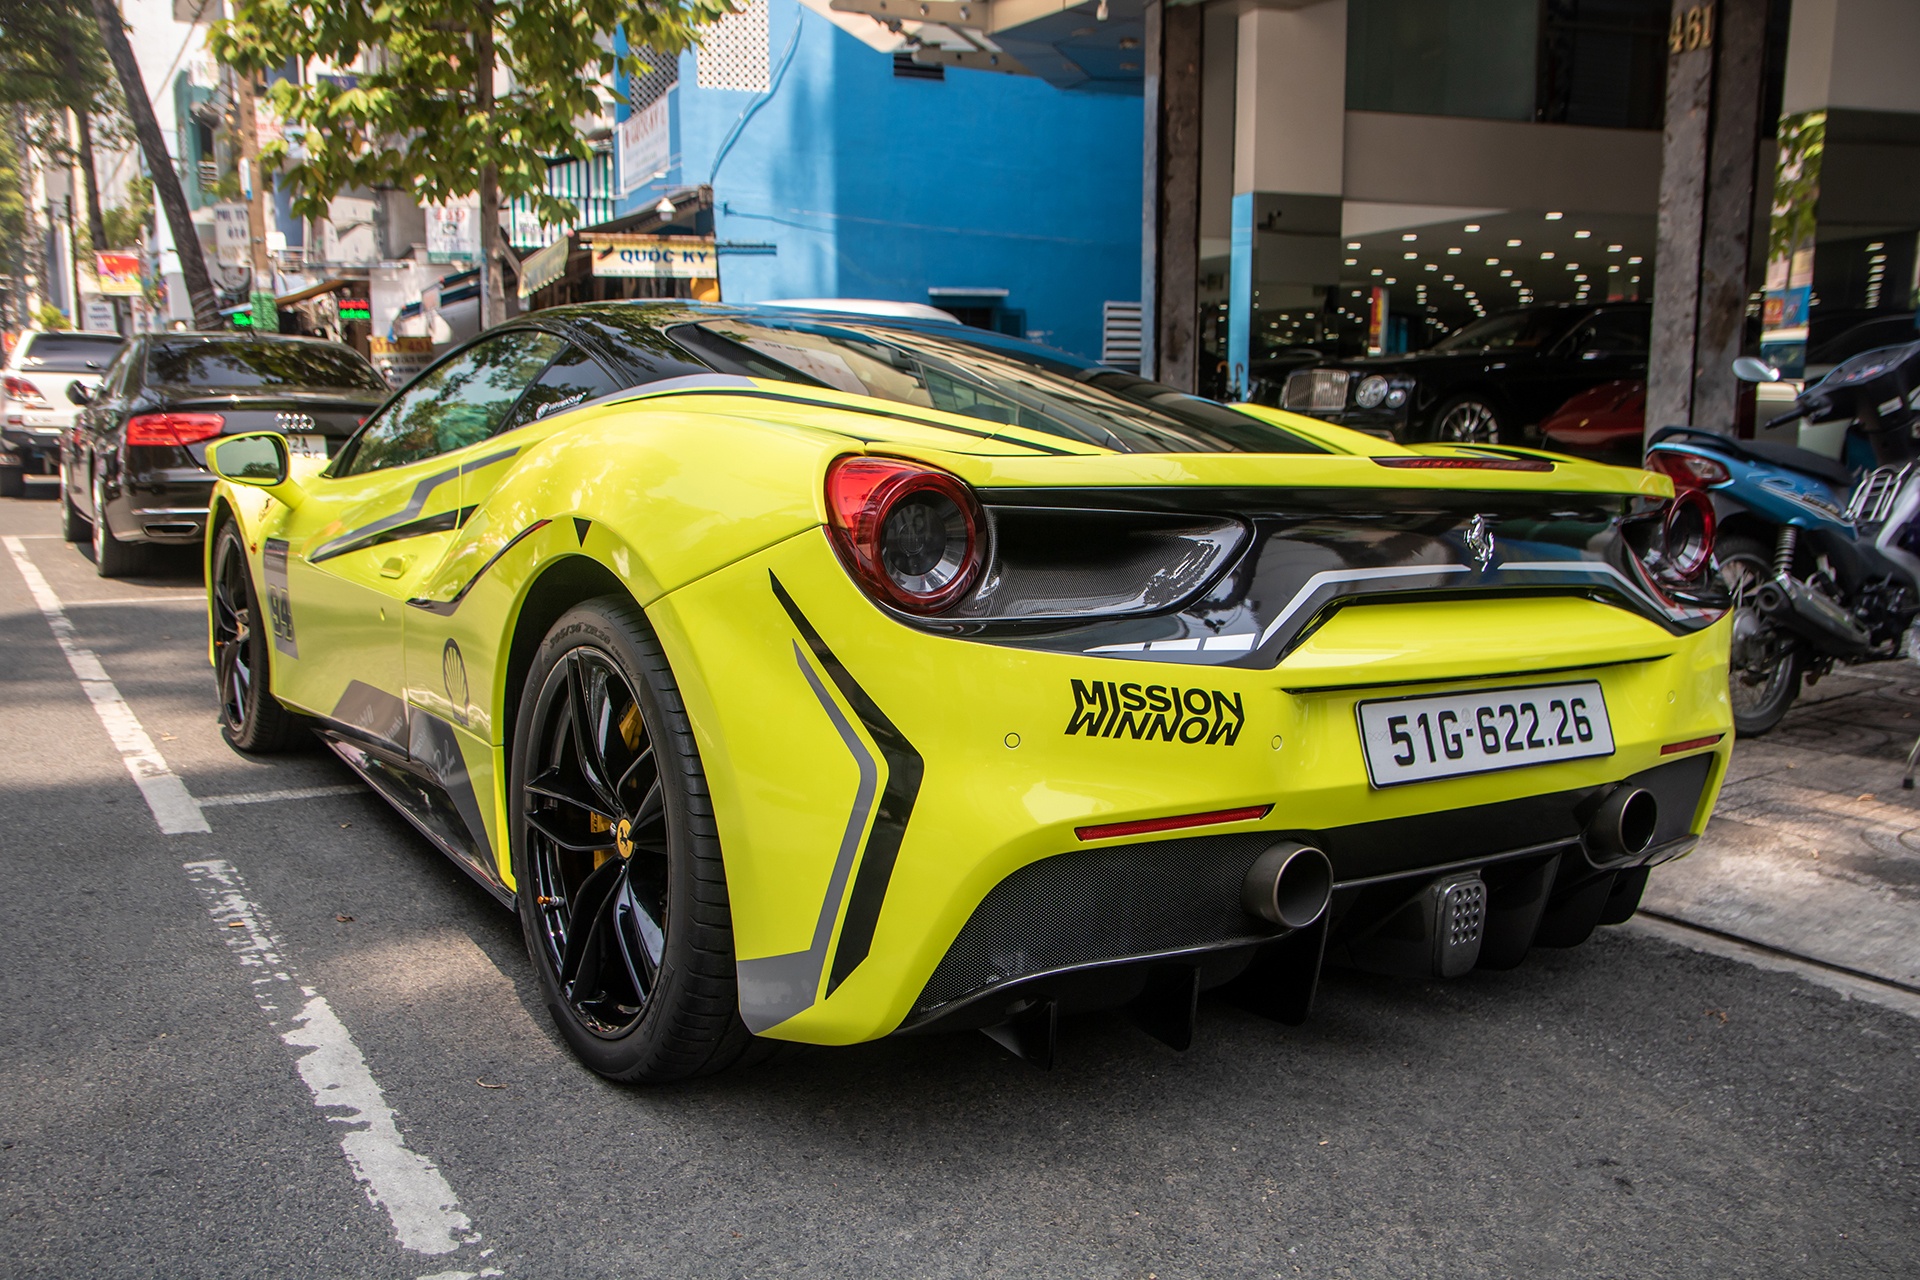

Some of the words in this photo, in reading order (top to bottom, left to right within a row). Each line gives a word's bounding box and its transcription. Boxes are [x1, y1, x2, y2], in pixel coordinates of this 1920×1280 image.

[1668, 4, 1713, 54] 461
[1070, 679, 1245, 720] MISSION
[1064, 708, 1245, 746] WINNOW
[1387, 698, 1594, 766] 51G-622.26
